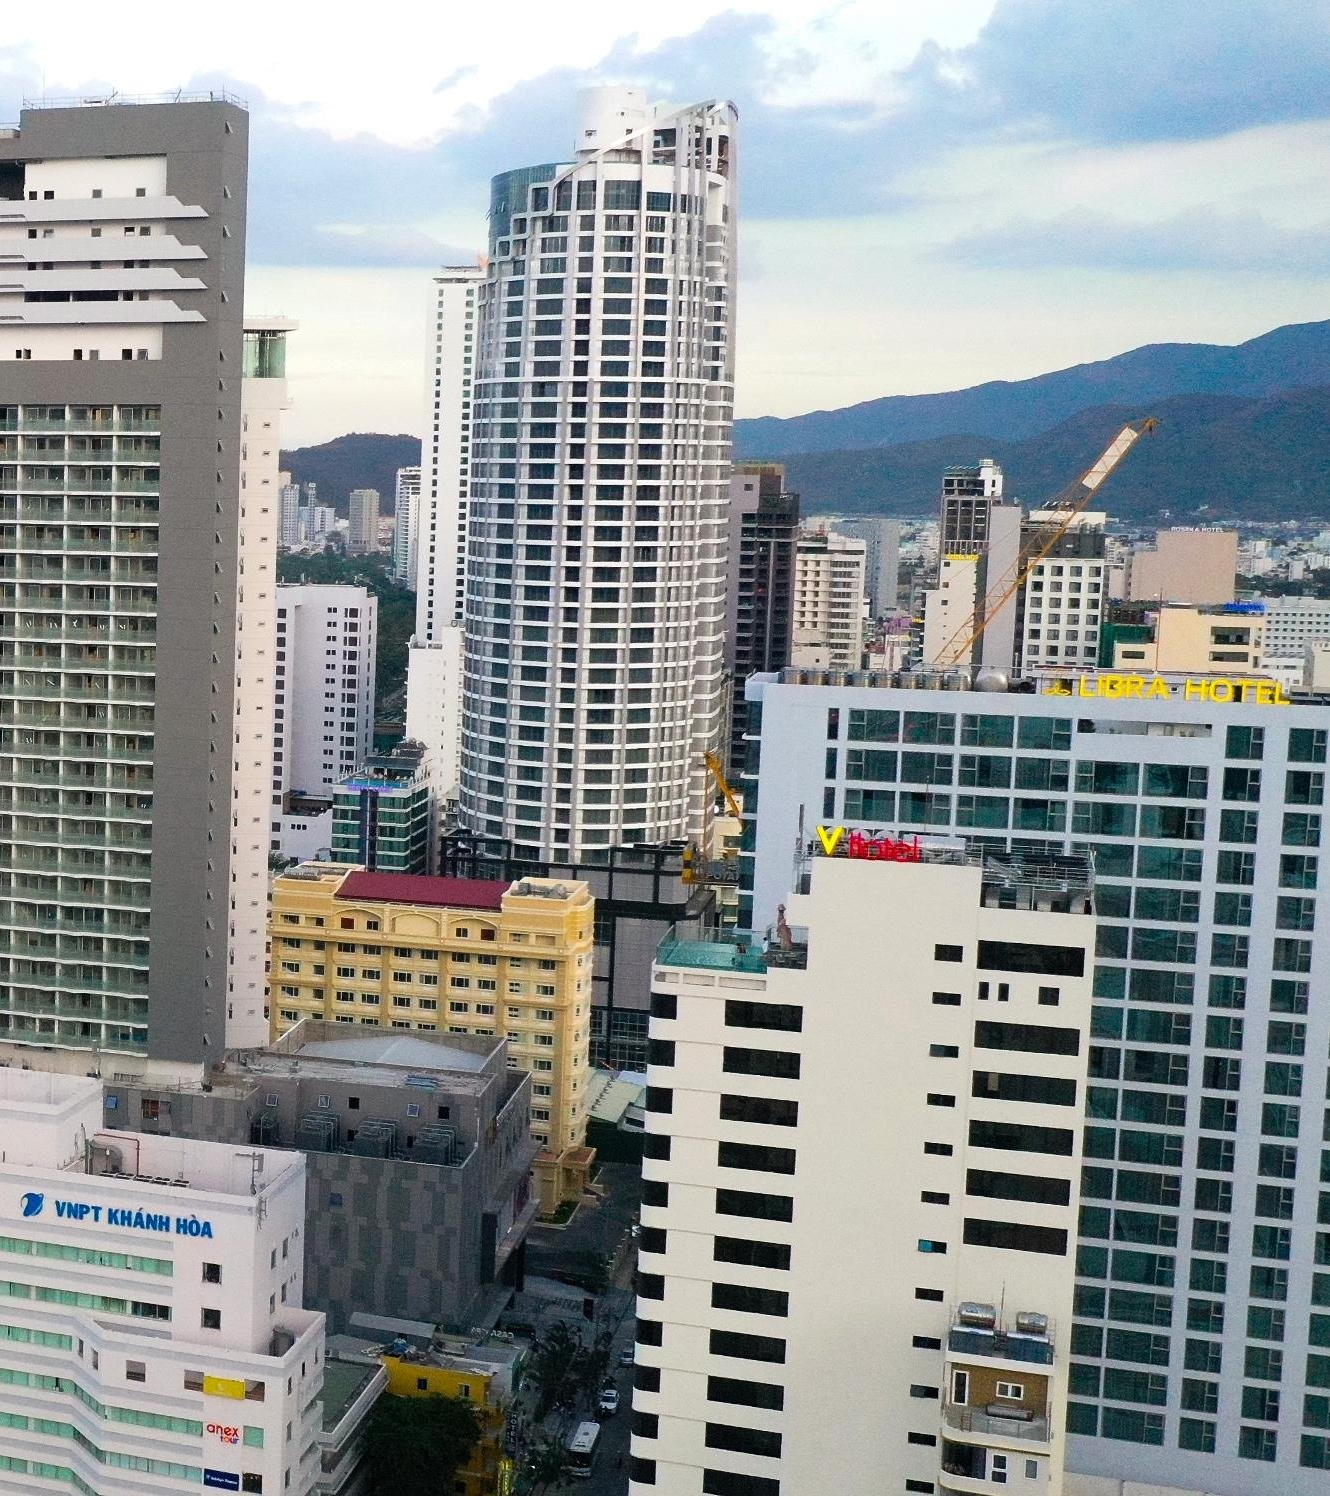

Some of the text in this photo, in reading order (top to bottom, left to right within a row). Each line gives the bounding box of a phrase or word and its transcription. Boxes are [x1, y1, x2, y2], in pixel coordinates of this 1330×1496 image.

[1078, 674, 1291, 705] LIBRA HOTEL
[815, 825, 845, 856] V
[55, 1200, 213, 1238] VNPT KHÁNH HÒA
[206, 1422, 240, 1438] anex
[220, 1435, 240, 1446] tour
